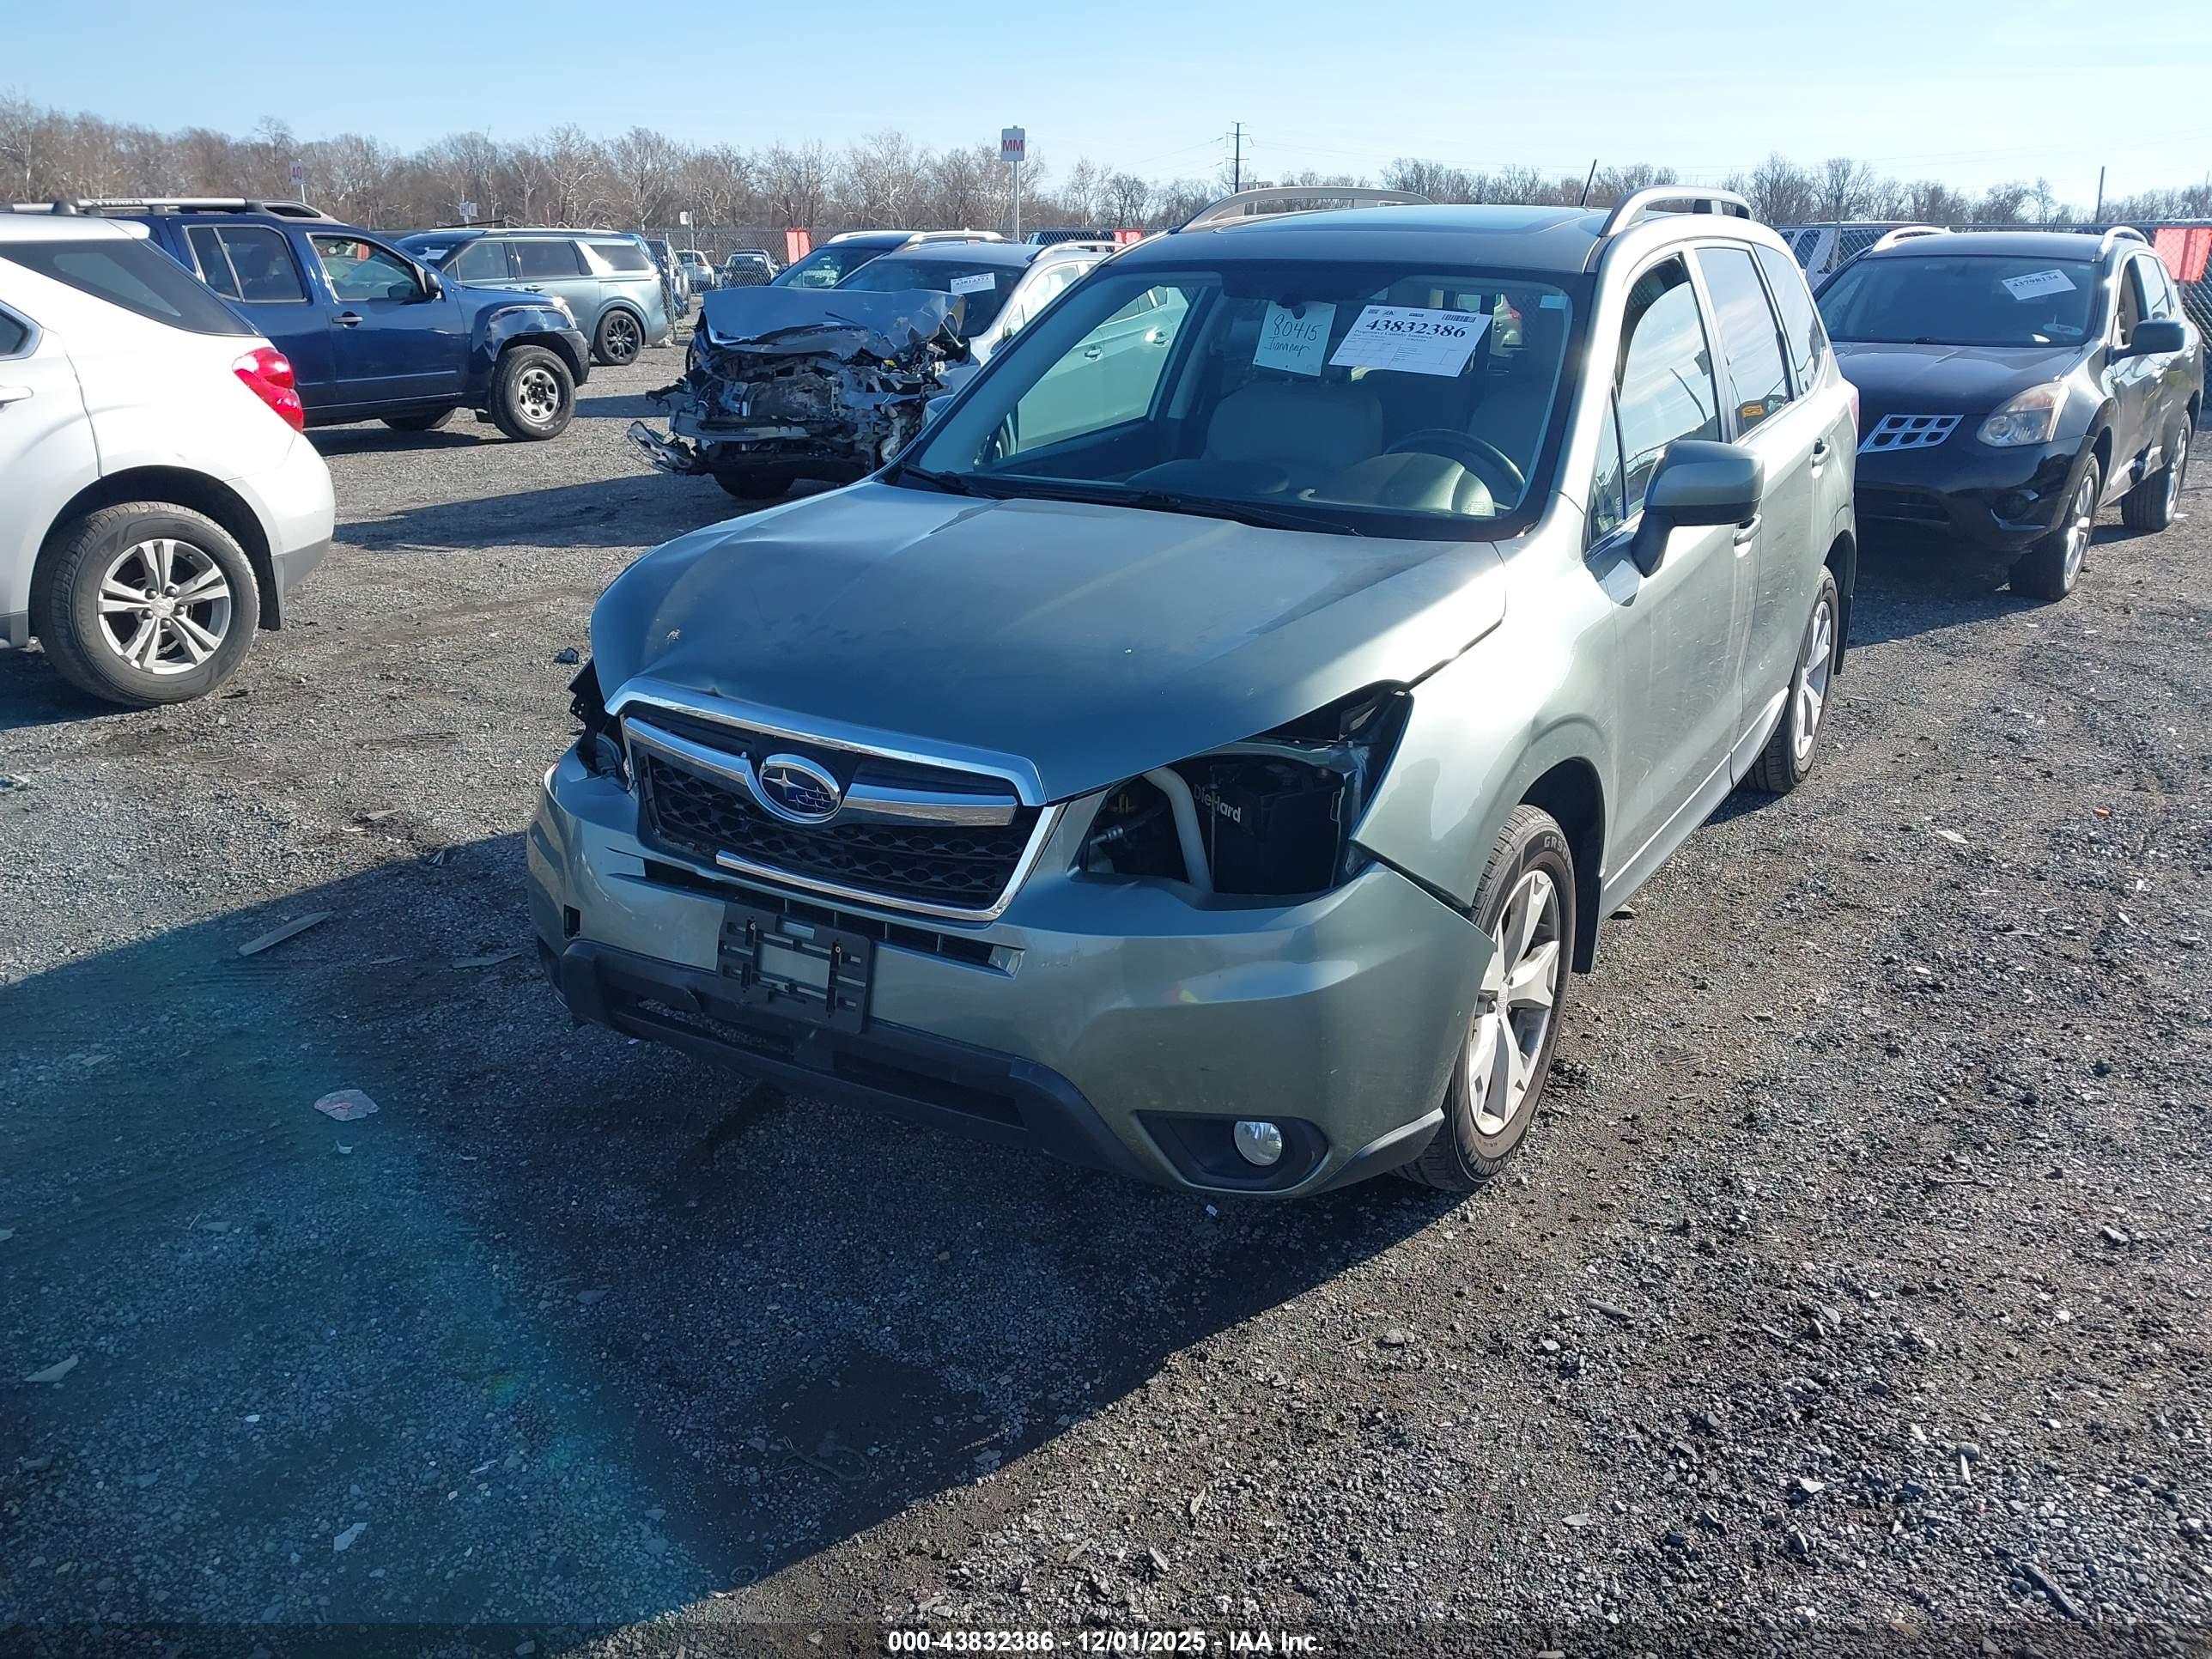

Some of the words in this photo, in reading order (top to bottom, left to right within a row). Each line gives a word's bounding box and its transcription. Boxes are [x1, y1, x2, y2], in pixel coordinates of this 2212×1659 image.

[1002, 139, 1024, 152] MM
[1273, 313, 1323, 342] 80415
[1365, 319, 1470, 338] 43832386
[1194, 782, 1242, 824] DieHard
